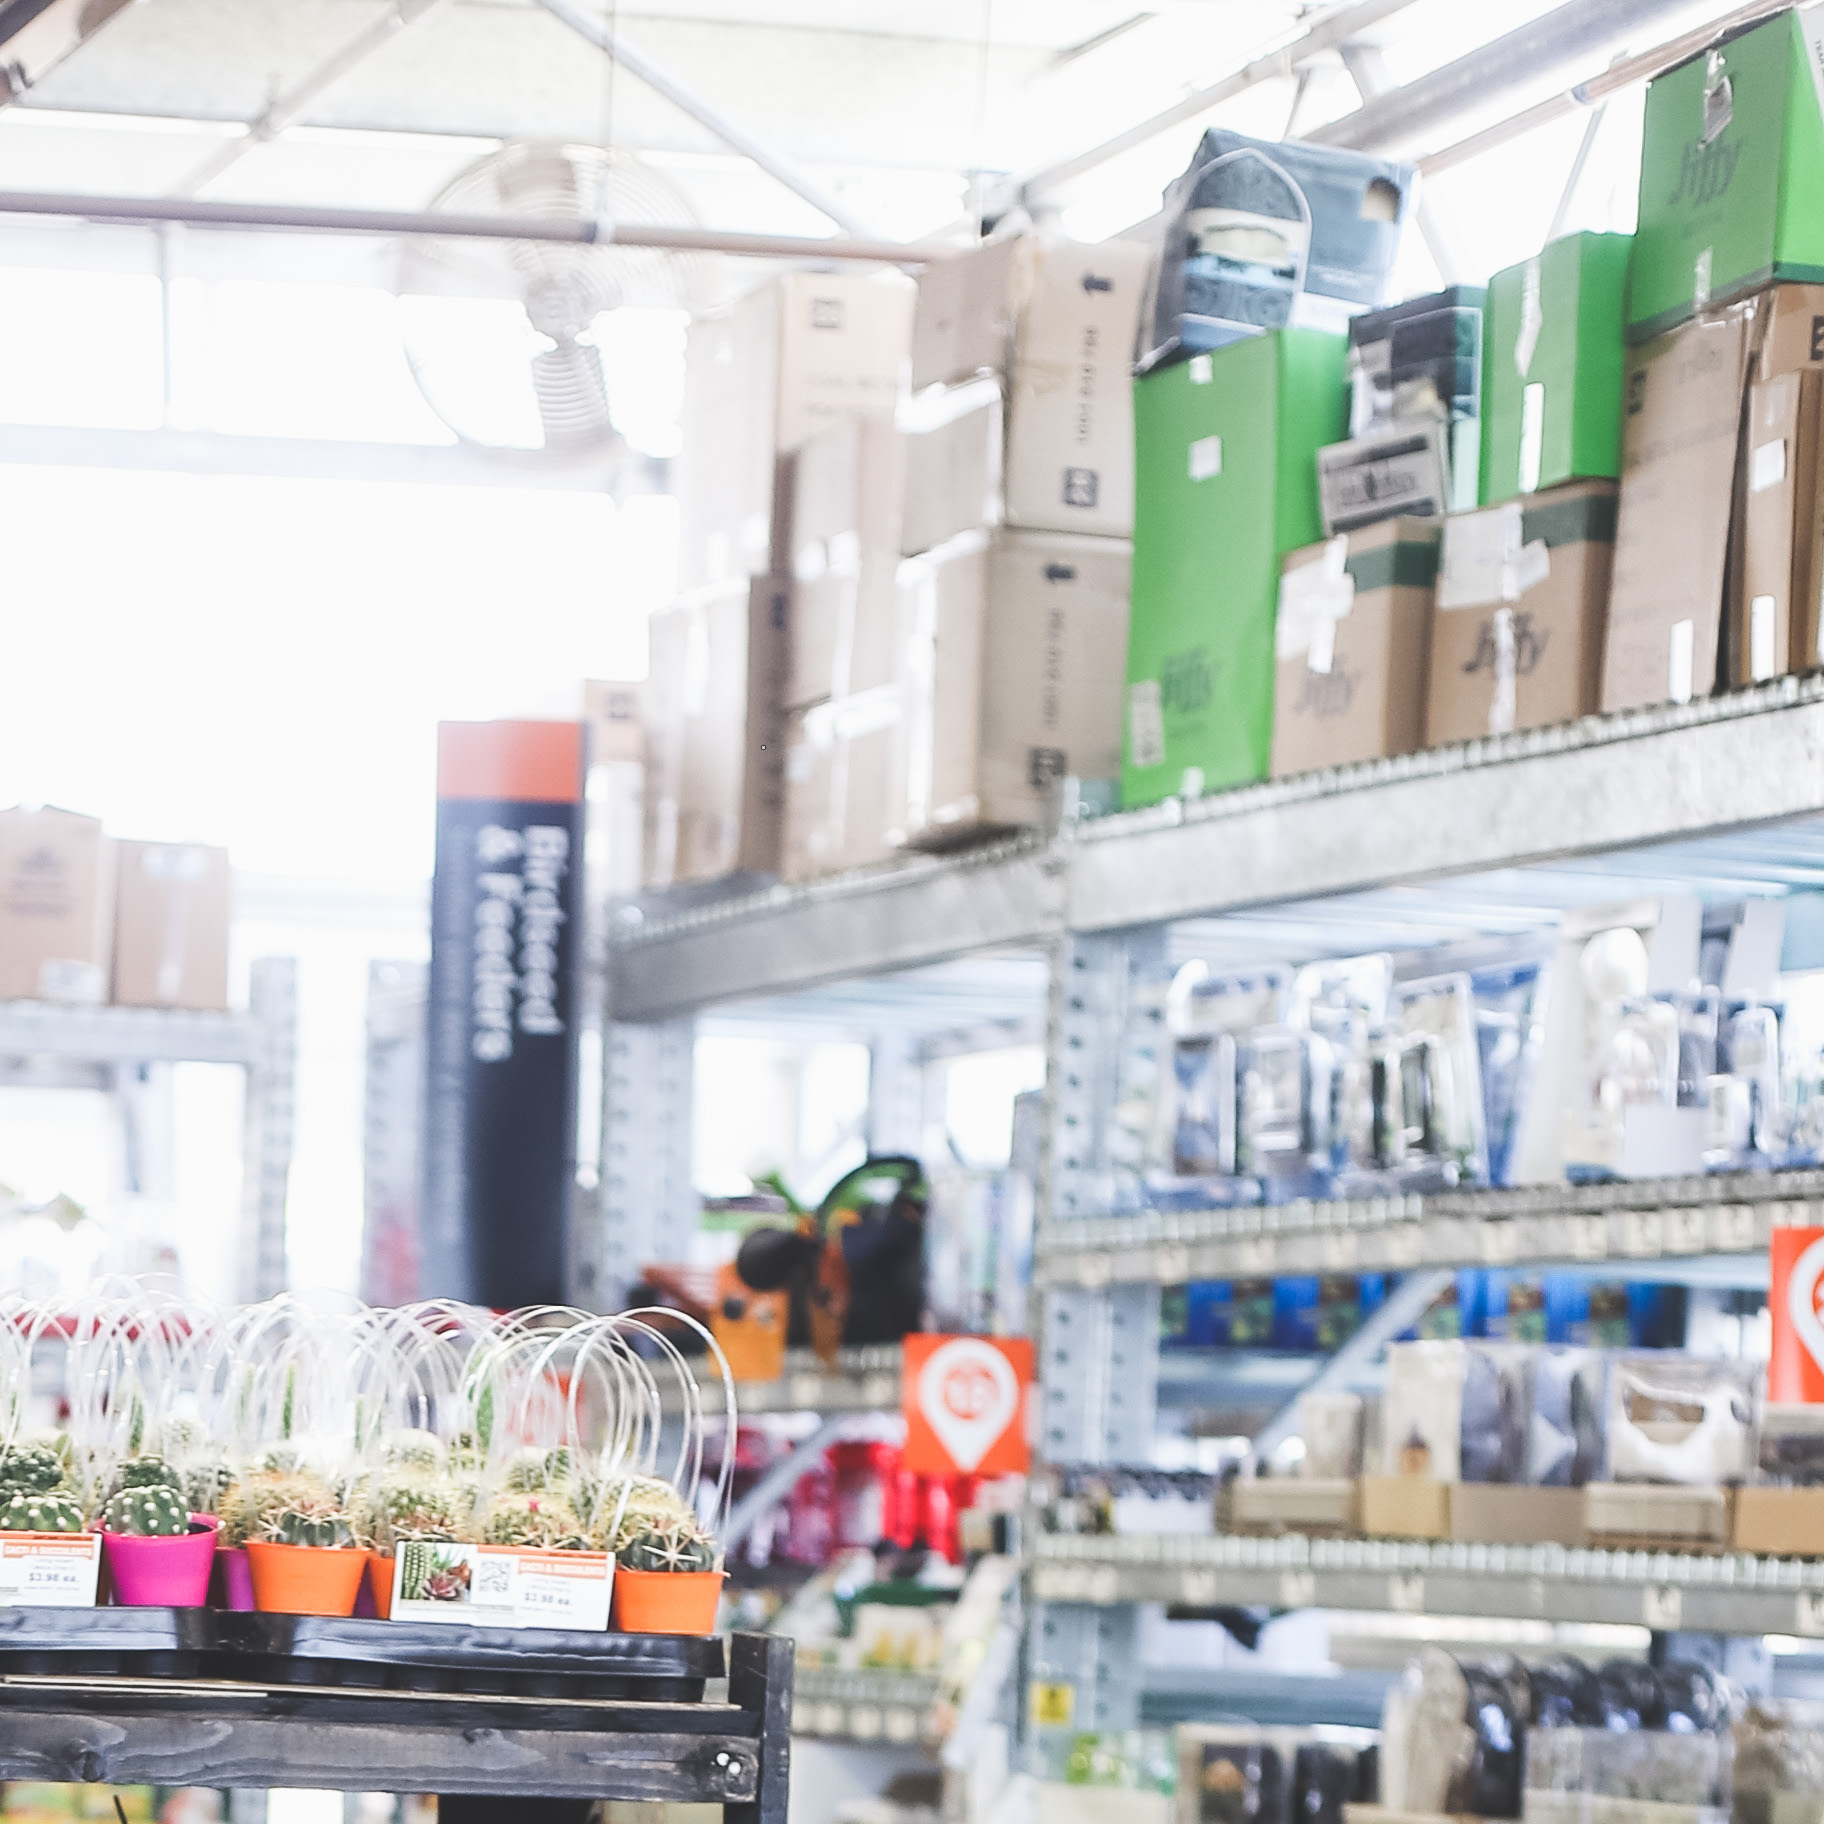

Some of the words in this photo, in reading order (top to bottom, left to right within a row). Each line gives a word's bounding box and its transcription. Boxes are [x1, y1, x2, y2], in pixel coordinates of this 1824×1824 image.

[478, 824, 521, 862] &
[473, 872, 521, 1063] Feeders
[518, 824, 570, 1035] Birdseed
[29, 1572, 59, 1582] $3.98
